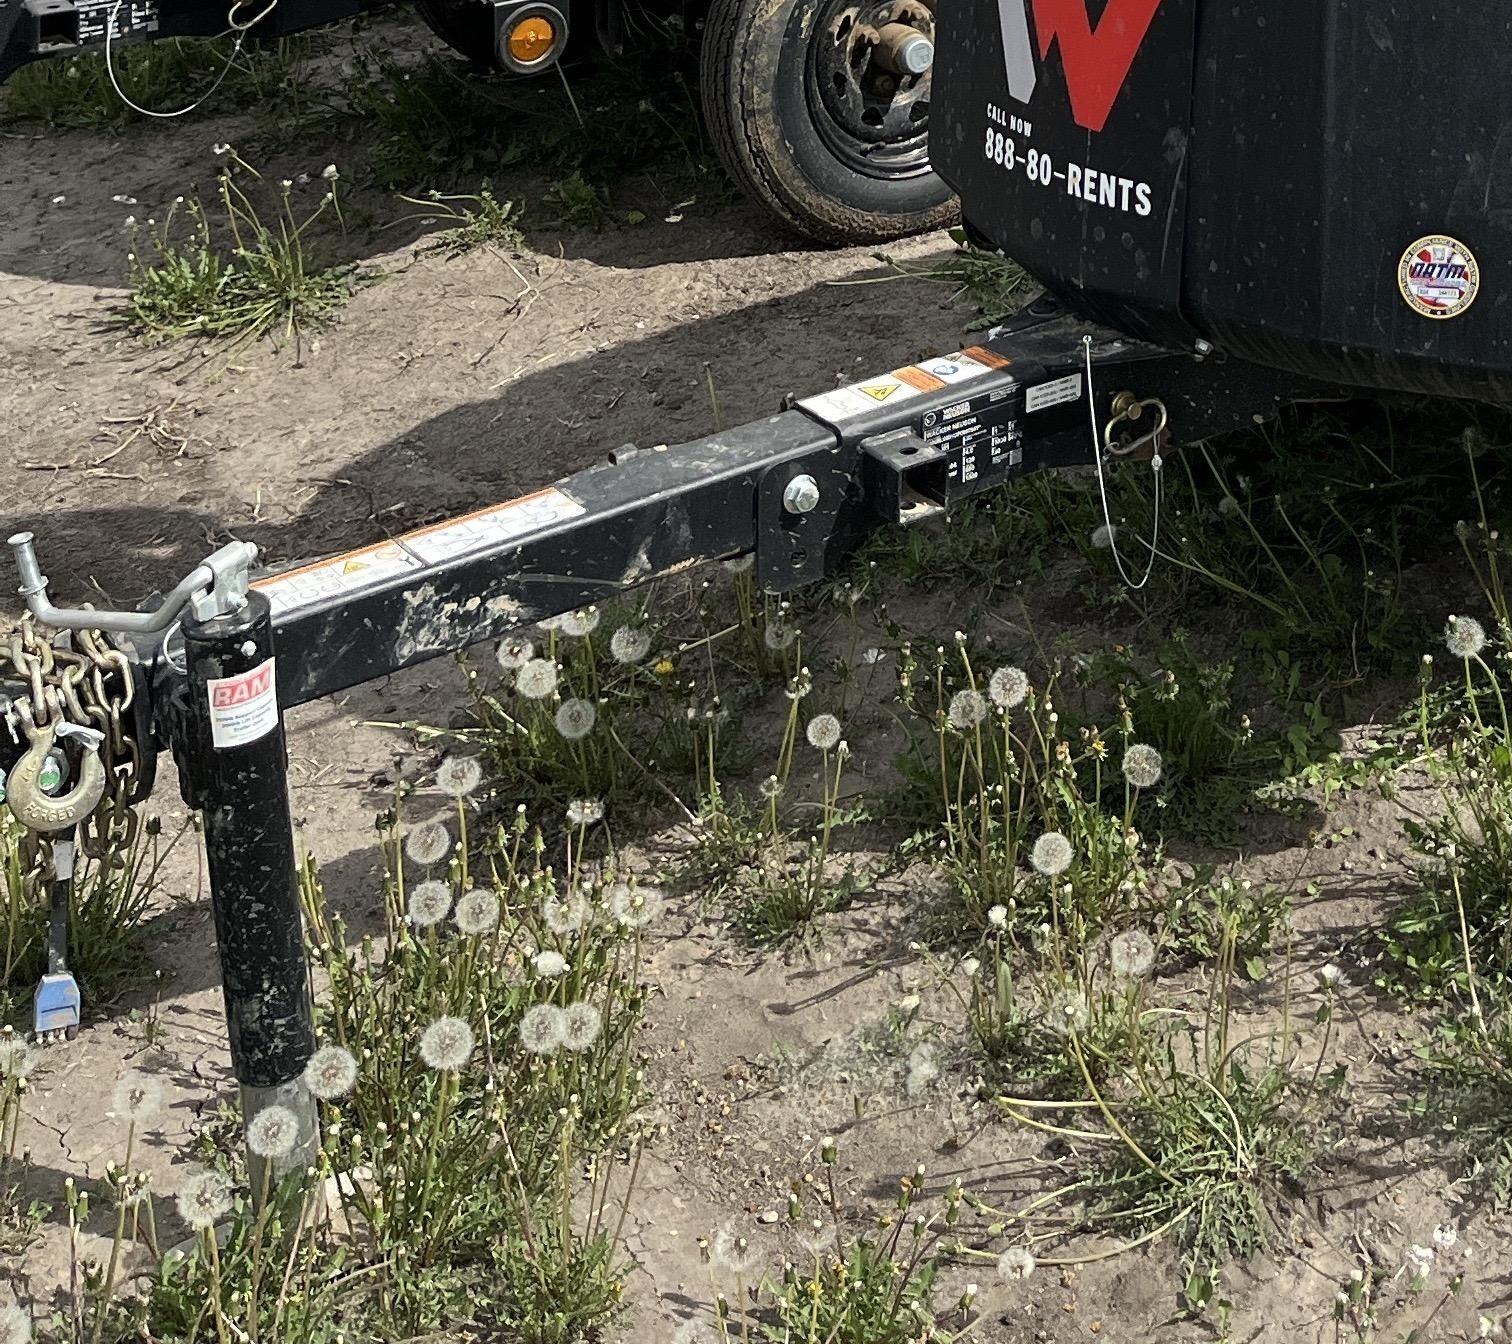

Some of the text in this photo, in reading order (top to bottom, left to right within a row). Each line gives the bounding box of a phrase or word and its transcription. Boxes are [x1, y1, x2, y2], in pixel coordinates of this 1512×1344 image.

[986, 102, 1033, 138] CALL NOW
[984, 127, 1152, 217] 888-80-RENTS
[213, 668, 270, 707] RAM
